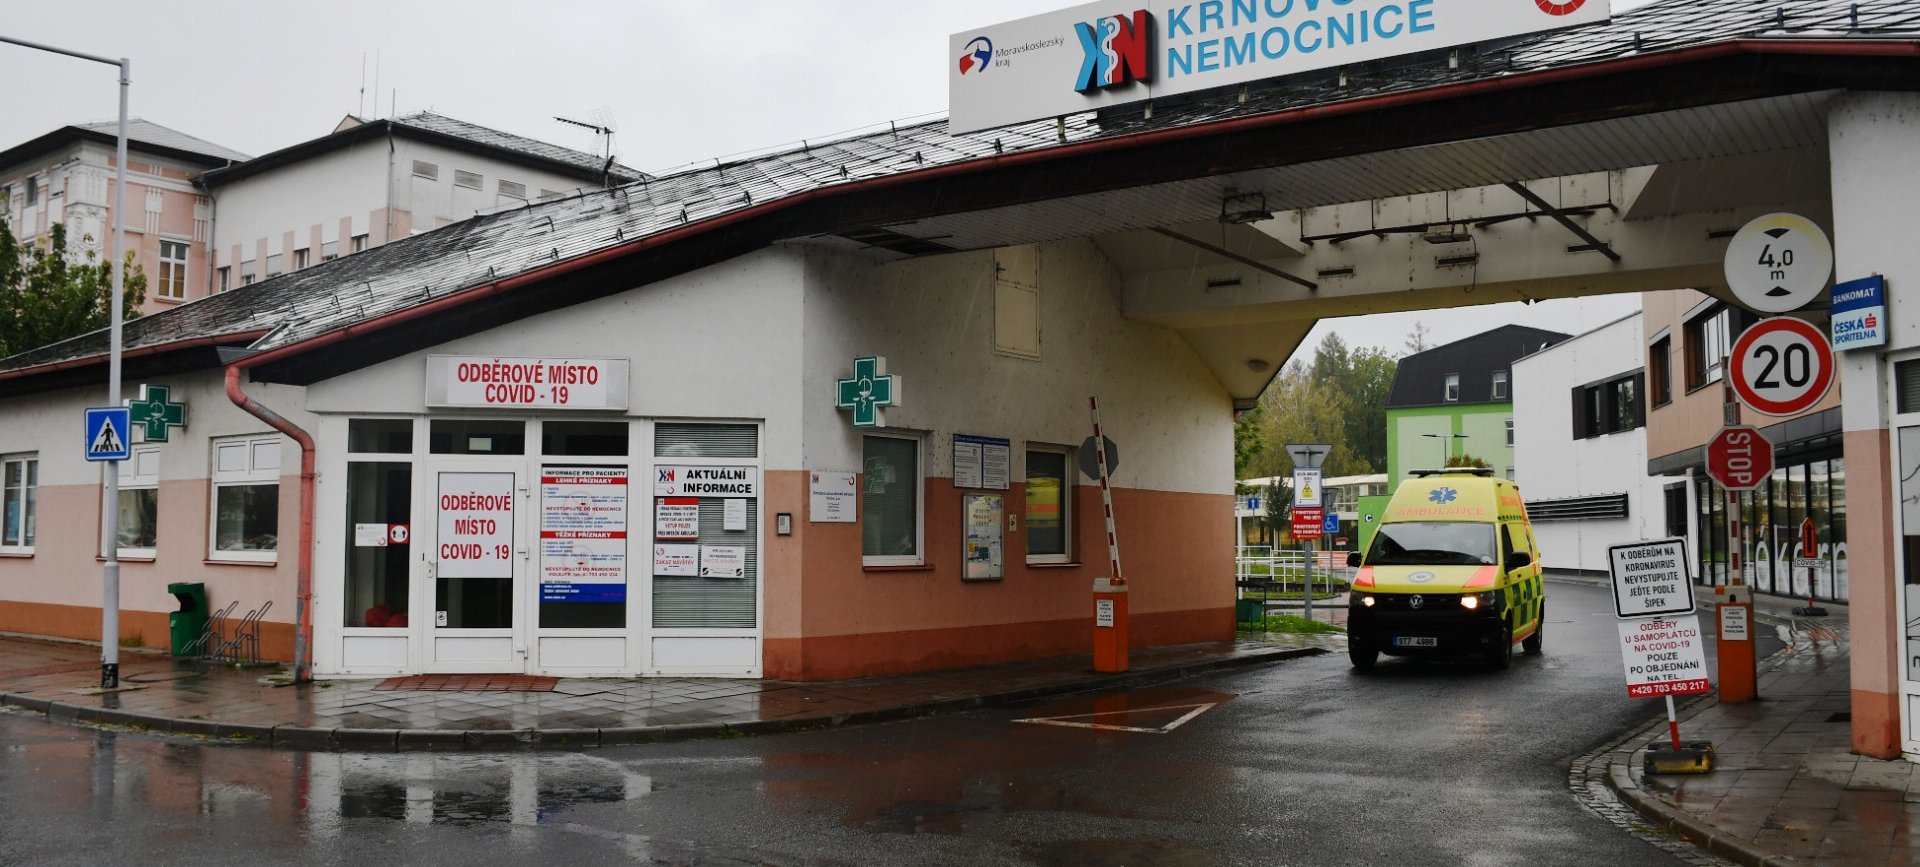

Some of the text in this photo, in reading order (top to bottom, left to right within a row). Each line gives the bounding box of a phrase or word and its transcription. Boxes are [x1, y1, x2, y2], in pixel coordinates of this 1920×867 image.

[995, 35, 1065, 58] Moravskoslezský
[1168, 1, 1435, 78] NEMOCNICE
[995, 58, 1010, 68] kraj
[1758, 244, 1793, 268] 4,0
[1771, 271, 1784, 280] m
[1833, 287, 1875, 305] BANKOMAT
[1834, 317, 1864, 334] ČESKÁ
[1835, 330, 1876, 344] SPOŘITELNA
[458, 359, 598, 385] ODBĚROVÉ MÍSTO
[1753, 343, 1810, 389] 20
[485, 384, 535, 403] COVID
[551, 386, 569, 404] 19
[1726, 432, 1752, 484] STOP
[686, 468, 746, 480] AKTUÁLNÍ
[683, 483, 752, 493] INFORMACE
[441, 491, 511, 511] ODBĚROVÉ
[1366, 514, 1373, 522] C
[1397, 507, 1485, 517] AMBULANCE
[455, 515, 496, 535] MÍSTO
[441, 544, 482, 559] COVID
[495, 545, 509, 559] 19
[1620, 547, 1675, 560] K ODBĚRŮM NA
[1625, 560, 1675, 572] KORONAVIRUS
[1624, 571, 1679, 584] NEVYSTUPUJTE
[1630, 584, 1675, 597] JEĎTE PODLE
[1644, 598, 1666, 608] ŠIPEK
[1634, 628, 1696, 643] SAMOPLÁTCŮ
[1649, 641, 1690, 651] COVID-19
[1647, 652, 1678, 662] POUZE
[1630, 659, 1699, 674] PO OBJEDNÁNÍ
[1631, 681, 1705, 694] +420 703 450 217
